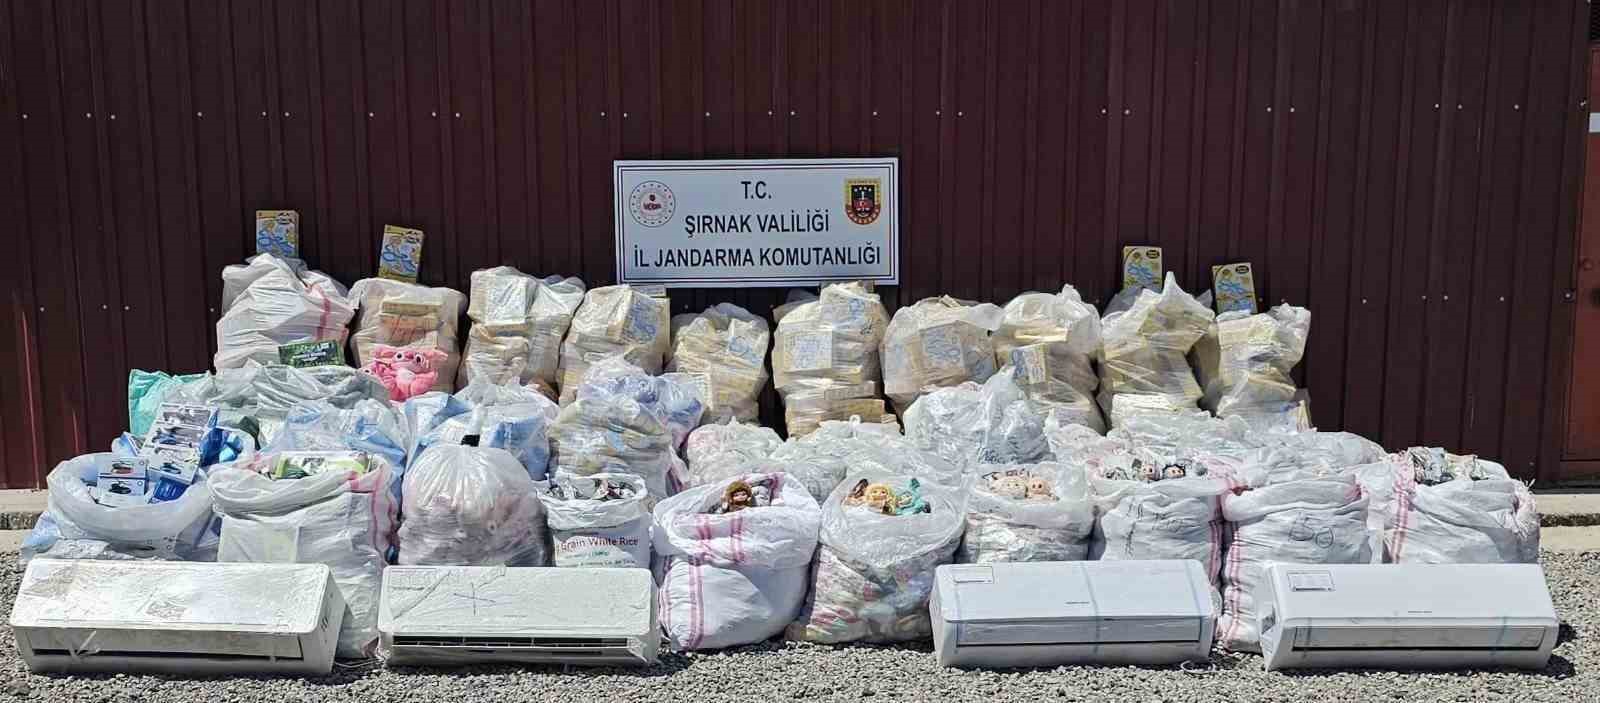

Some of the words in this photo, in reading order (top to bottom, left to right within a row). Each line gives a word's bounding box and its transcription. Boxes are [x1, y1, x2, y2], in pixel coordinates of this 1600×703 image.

[741, 181, 772, 199] T.C.
[685, 214, 752, 238] ŞIRNAK
[757, 208, 829, 233] VALİLİĞİ
[634, 245, 650, 267] İL
[654, 248, 754, 267] JANDARMA
[760, 241, 880, 266] KOMUTANLIĞI
[589, 536, 617, 546] White
[619, 536, 639, 546] Rice
